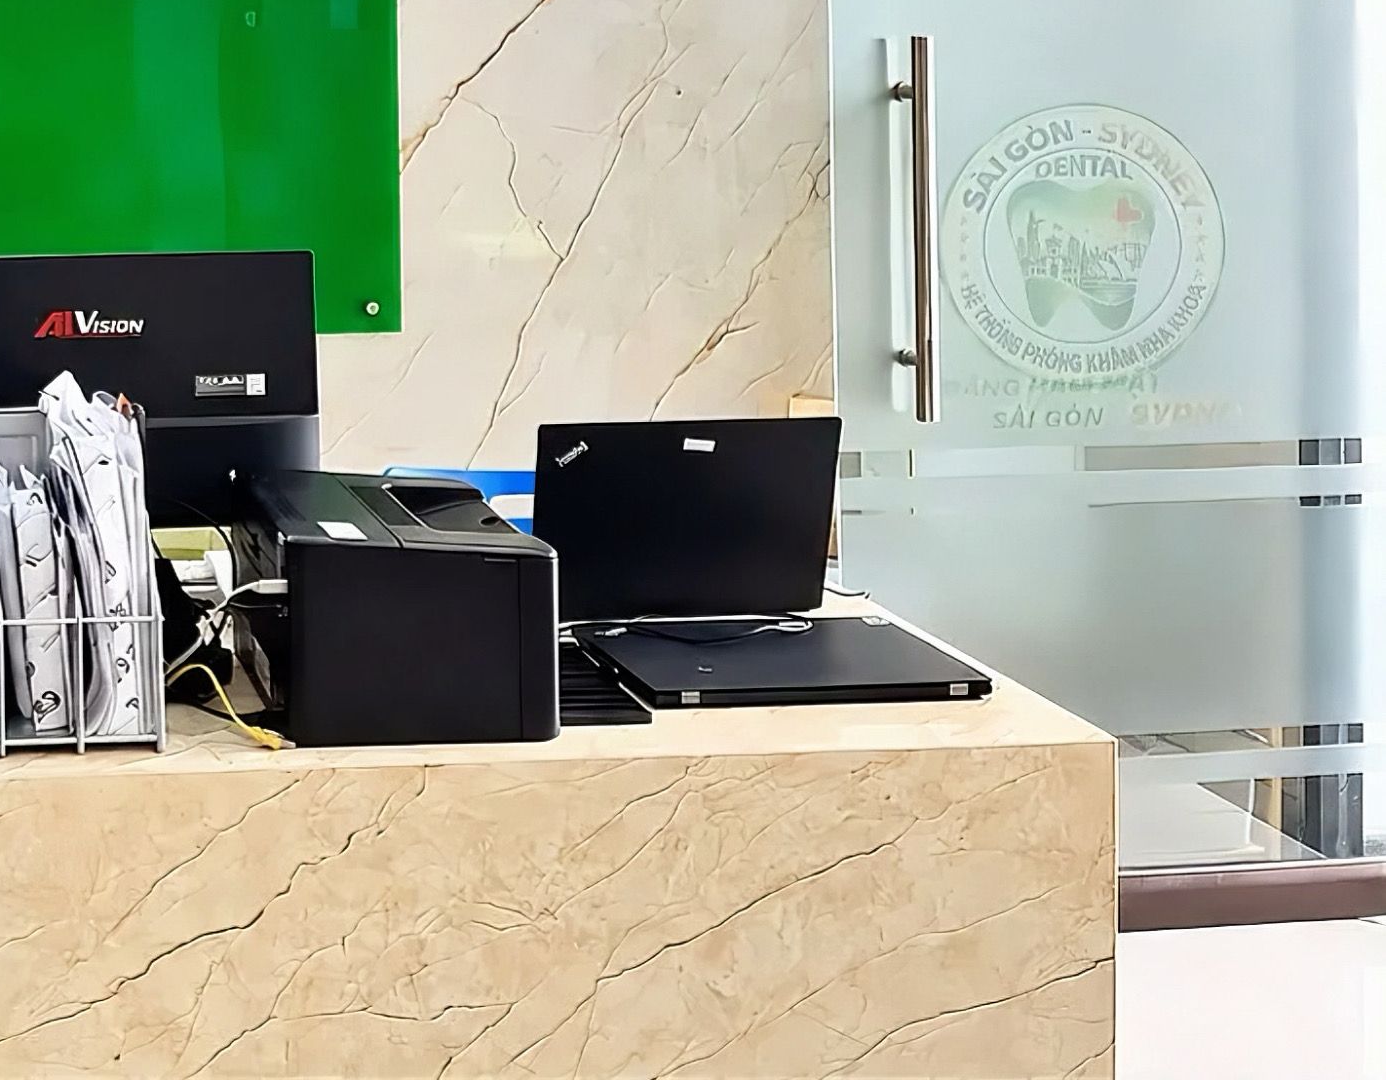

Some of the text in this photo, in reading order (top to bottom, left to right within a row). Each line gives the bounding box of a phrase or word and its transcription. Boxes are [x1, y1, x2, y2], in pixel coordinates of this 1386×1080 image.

[964, 156, 1007, 213] SÀI
[1005, 119, 1073, 161] GÒN
[1034, 153, 1134, 181] DENTAL
